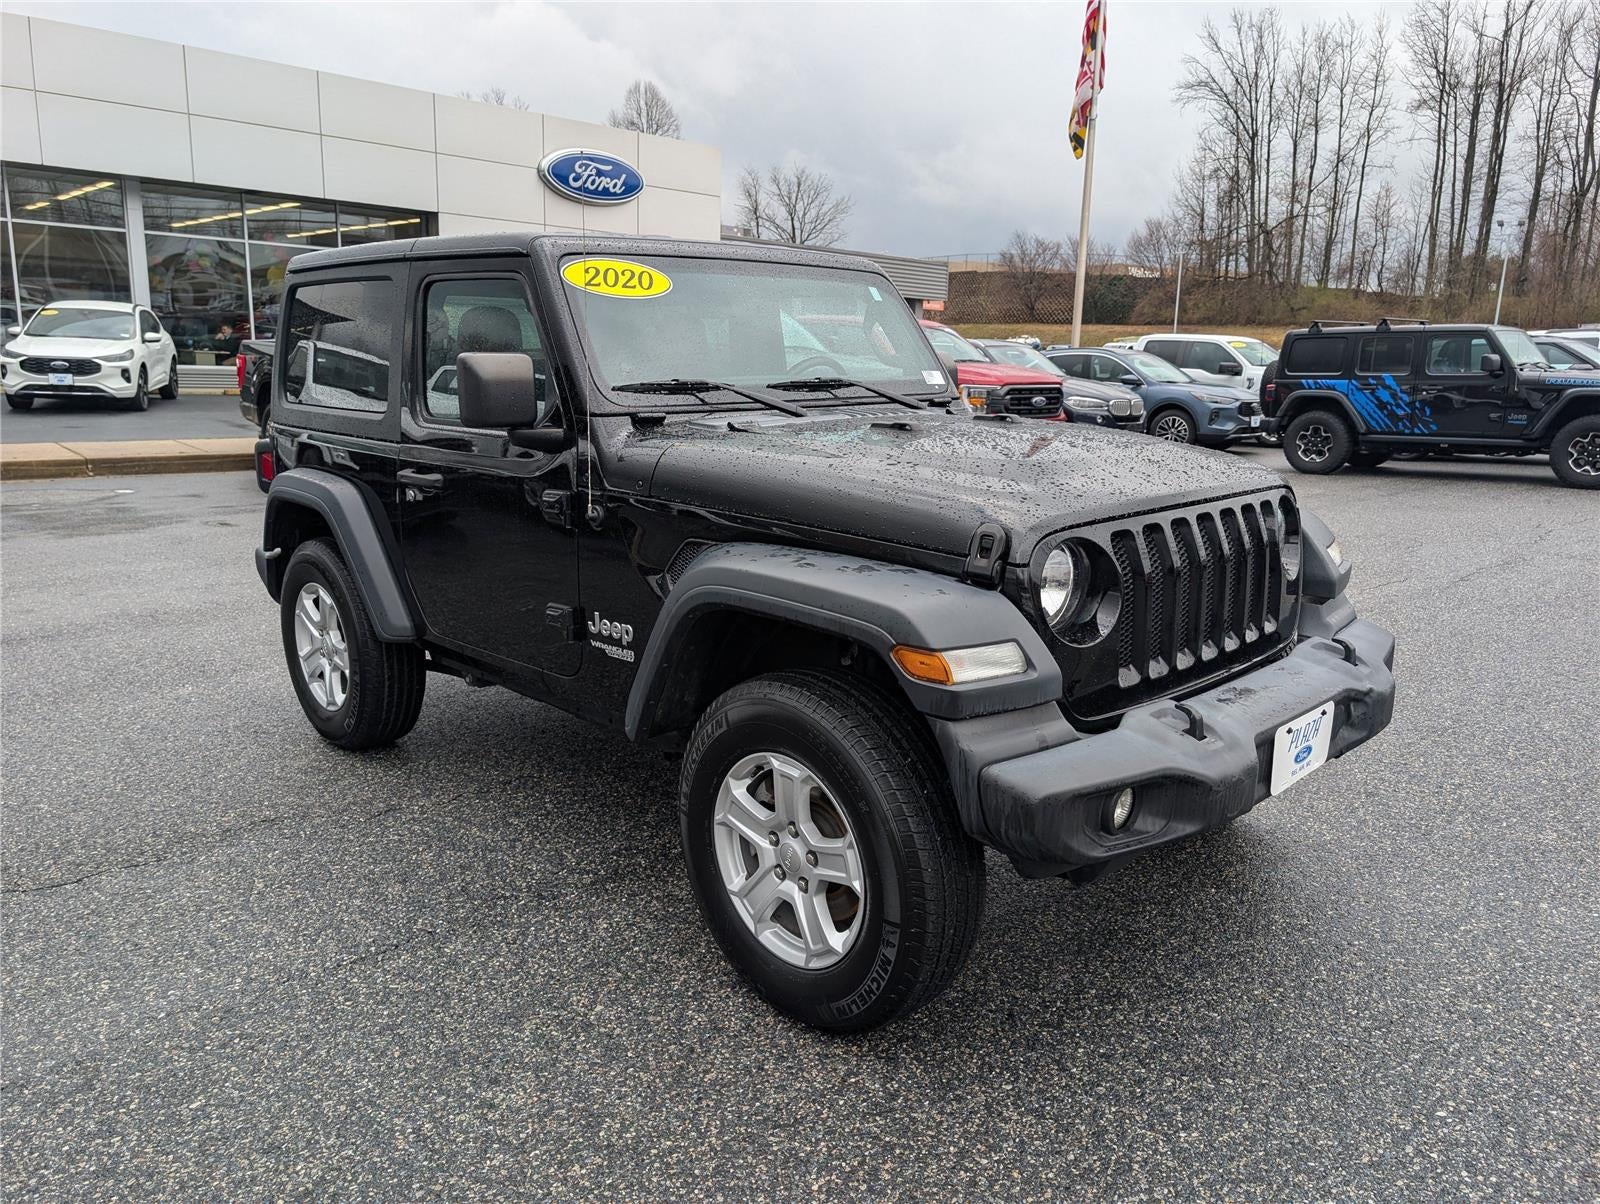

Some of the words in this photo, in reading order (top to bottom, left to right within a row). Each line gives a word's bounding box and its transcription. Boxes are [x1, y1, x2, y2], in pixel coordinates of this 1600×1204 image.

[568, 160, 626, 193] Ford
[584, 266, 653, 290] 2020
[587, 611, 634, 646] Jeep
[590, 639, 635, 657] WRANGLER
[1287, 715, 1324, 753] PLAZA
[831, 949, 896, 1018] MICHELIN
